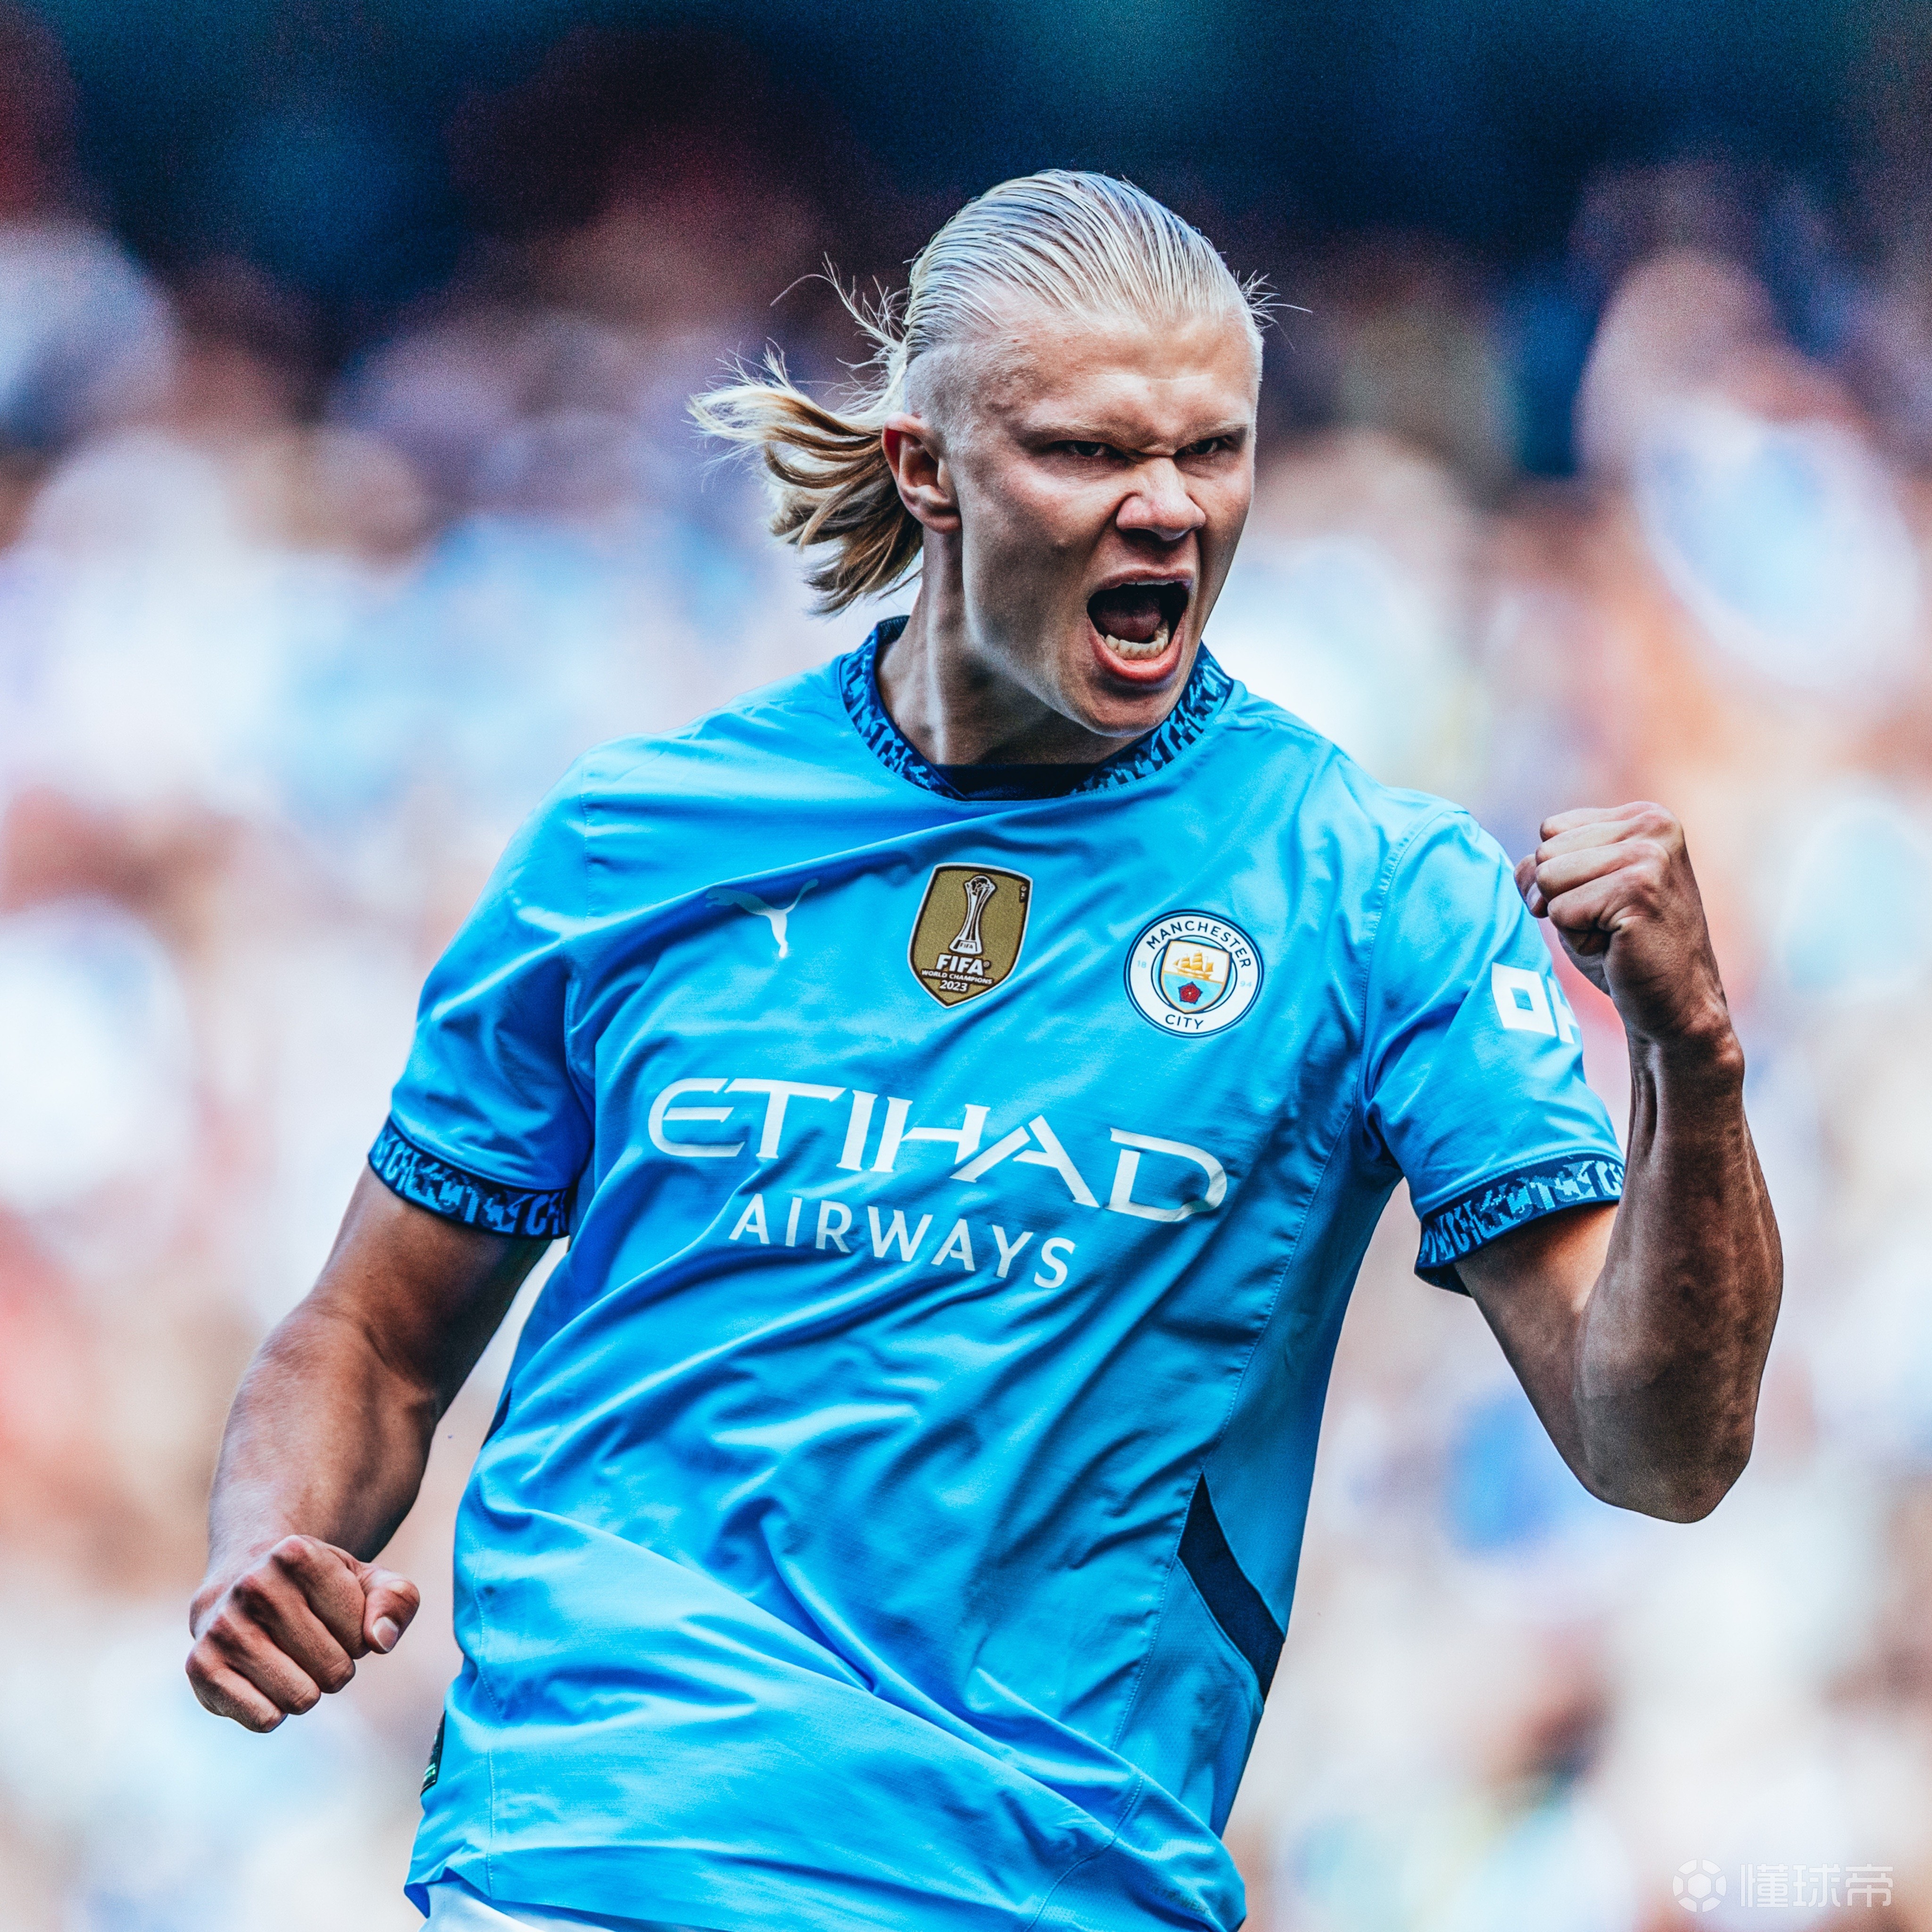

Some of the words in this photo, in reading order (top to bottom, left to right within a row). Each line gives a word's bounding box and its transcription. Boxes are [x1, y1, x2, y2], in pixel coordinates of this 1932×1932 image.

[1146, 920, 1251, 968] MANCHESTER
[1137, 960, 1147, 968] 18
[922, 970, 948, 978] WORLD
[949, 974, 993, 985] CHAMPIONS
[939, 980, 968, 992] 2023
[1165, 1014, 1204, 1030] CITY
[648, 1077, 1227, 1223] ETIHAD
[729, 1193, 1076, 1289] AIRWAYS
